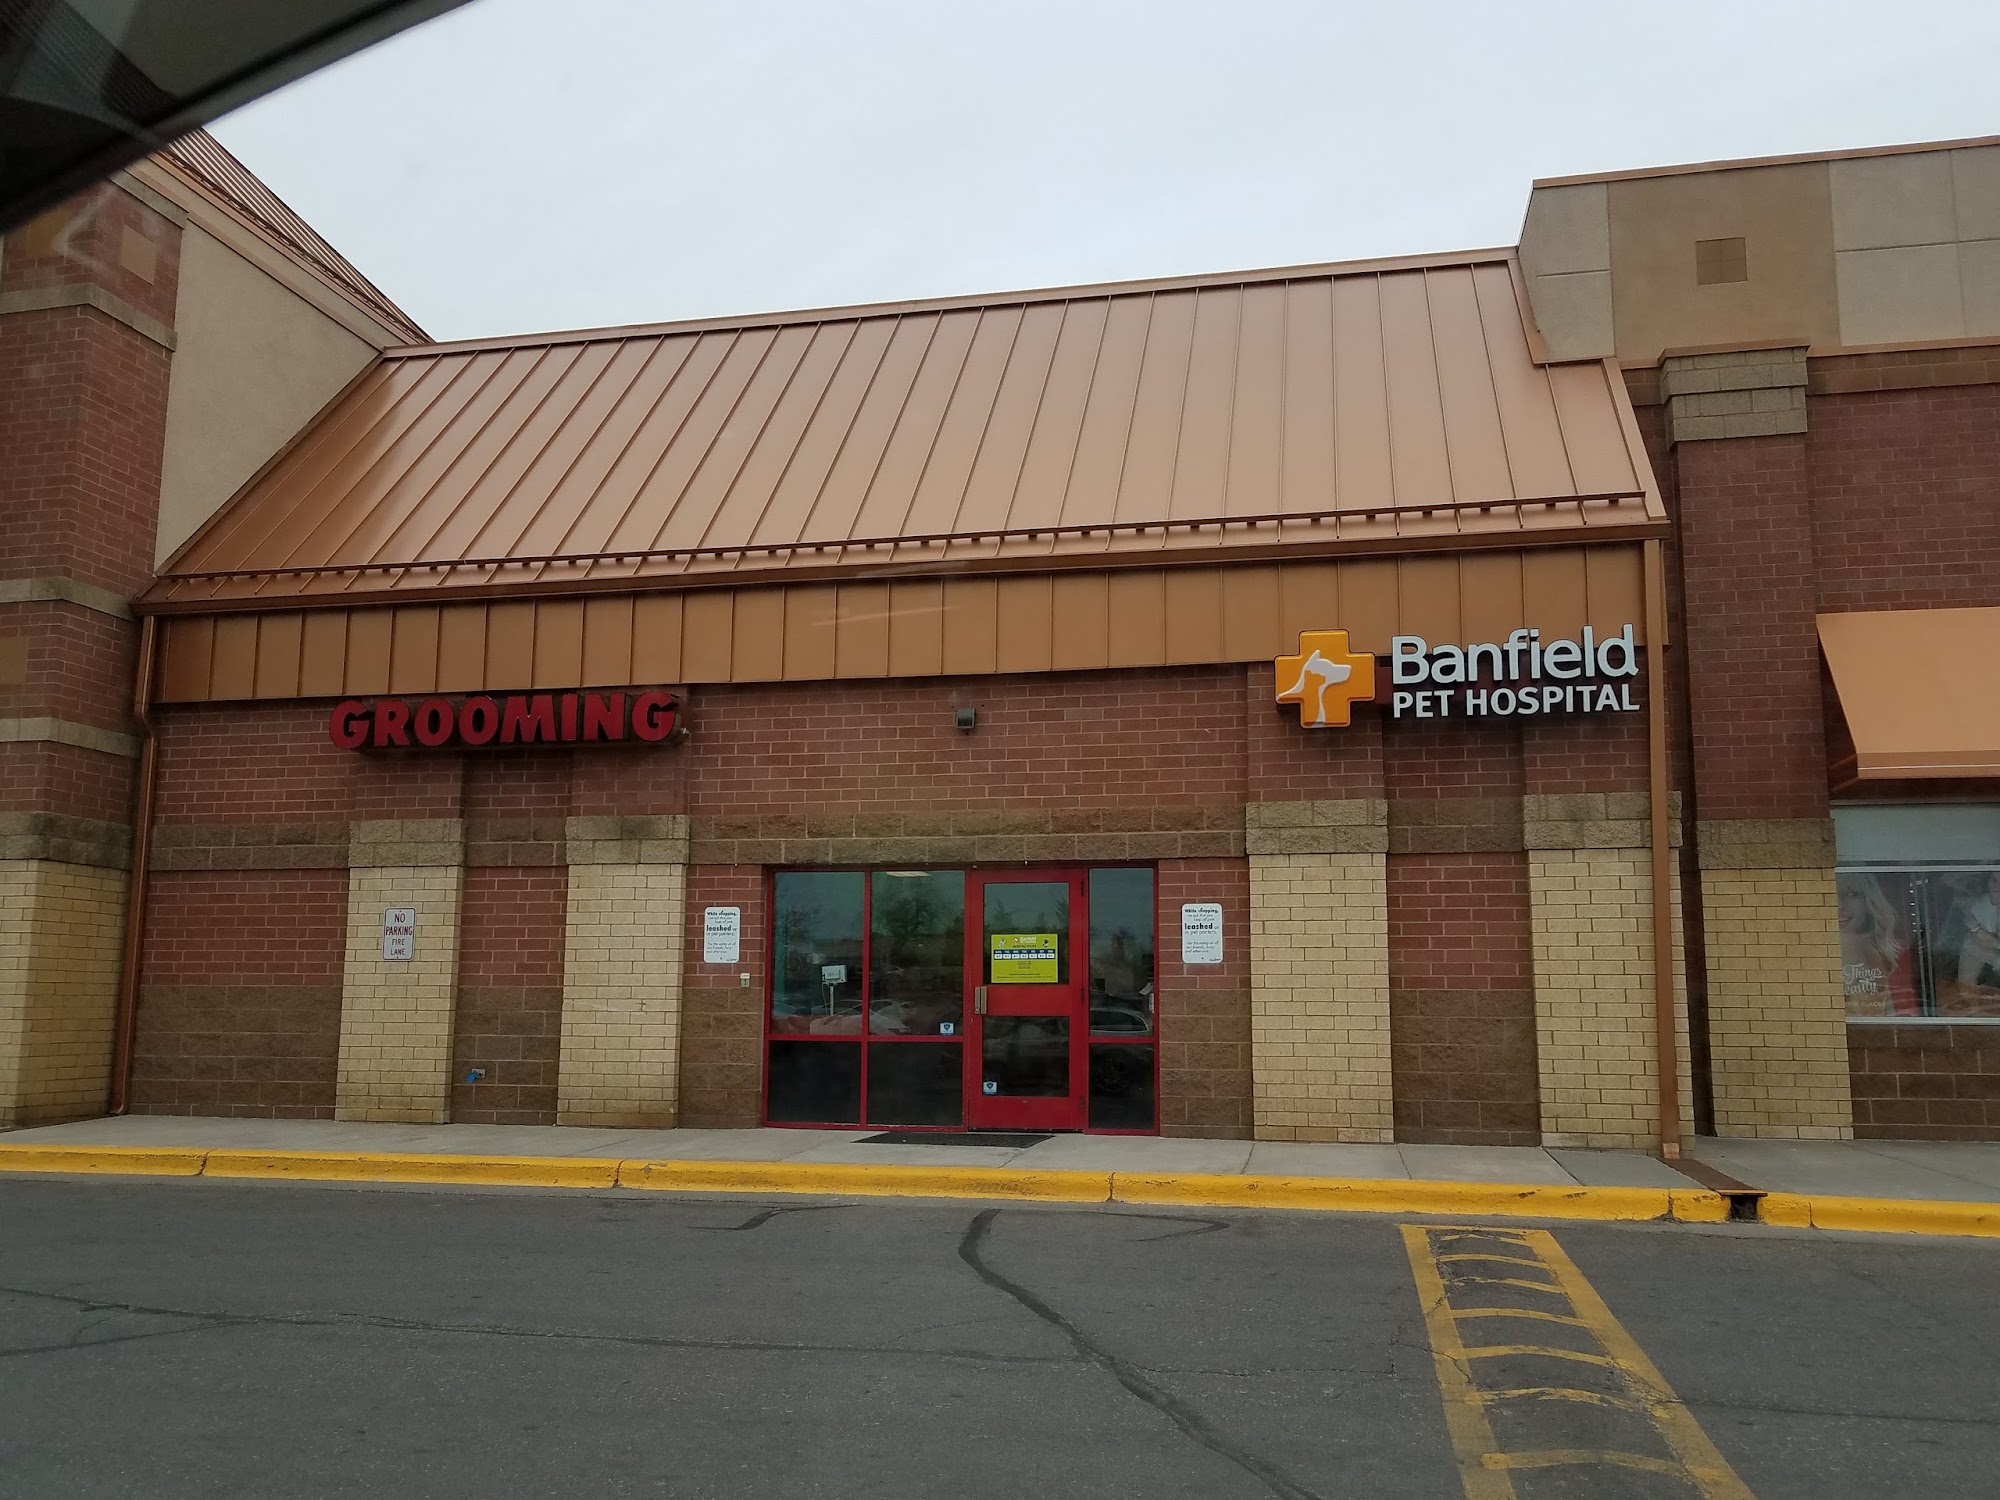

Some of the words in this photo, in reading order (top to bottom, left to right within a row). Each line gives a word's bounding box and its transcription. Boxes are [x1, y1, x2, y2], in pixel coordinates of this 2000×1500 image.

[1391, 624, 1639, 684] Banfield
[1393, 690, 1454, 718] PET
[1466, 684, 1640, 716] HOSPITAL
[329, 690, 679, 749] GROOMING
[394, 913, 406, 923] NO
[385, 926, 413, 936] PARKING
[391, 938, 405, 946] FIRE
[390, 948, 405, 956] LANE
[1843, 962, 1883, 985] Things
[1844, 978, 1878, 995] eauty
